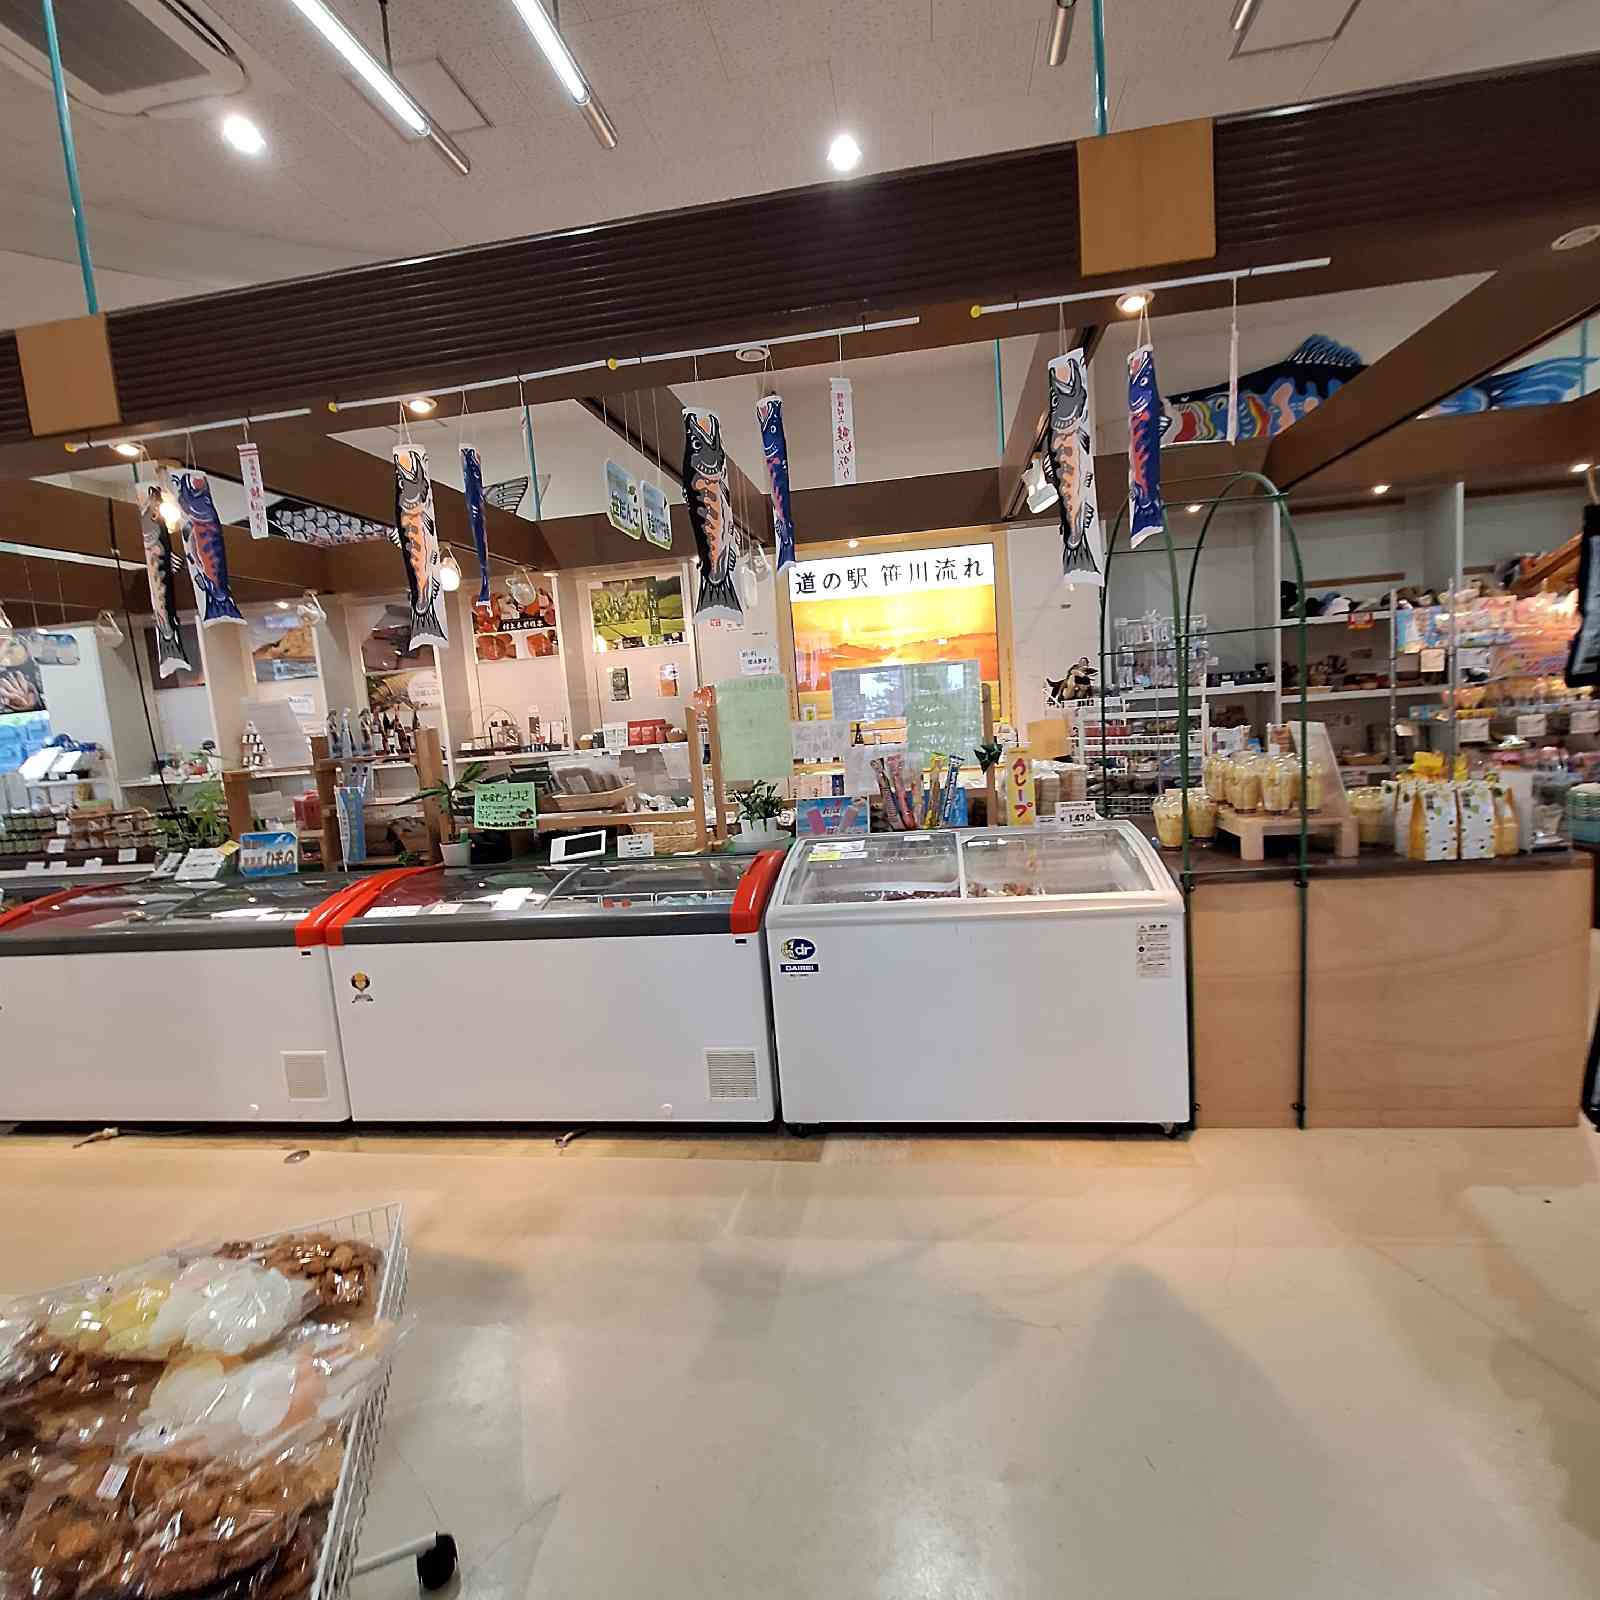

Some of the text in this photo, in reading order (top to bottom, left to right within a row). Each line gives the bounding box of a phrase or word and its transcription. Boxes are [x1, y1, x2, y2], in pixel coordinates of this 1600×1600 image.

[794, 556, 985, 595] 道の駅 笹川流れ
[1012, 758, 1033, 818] クレープ
